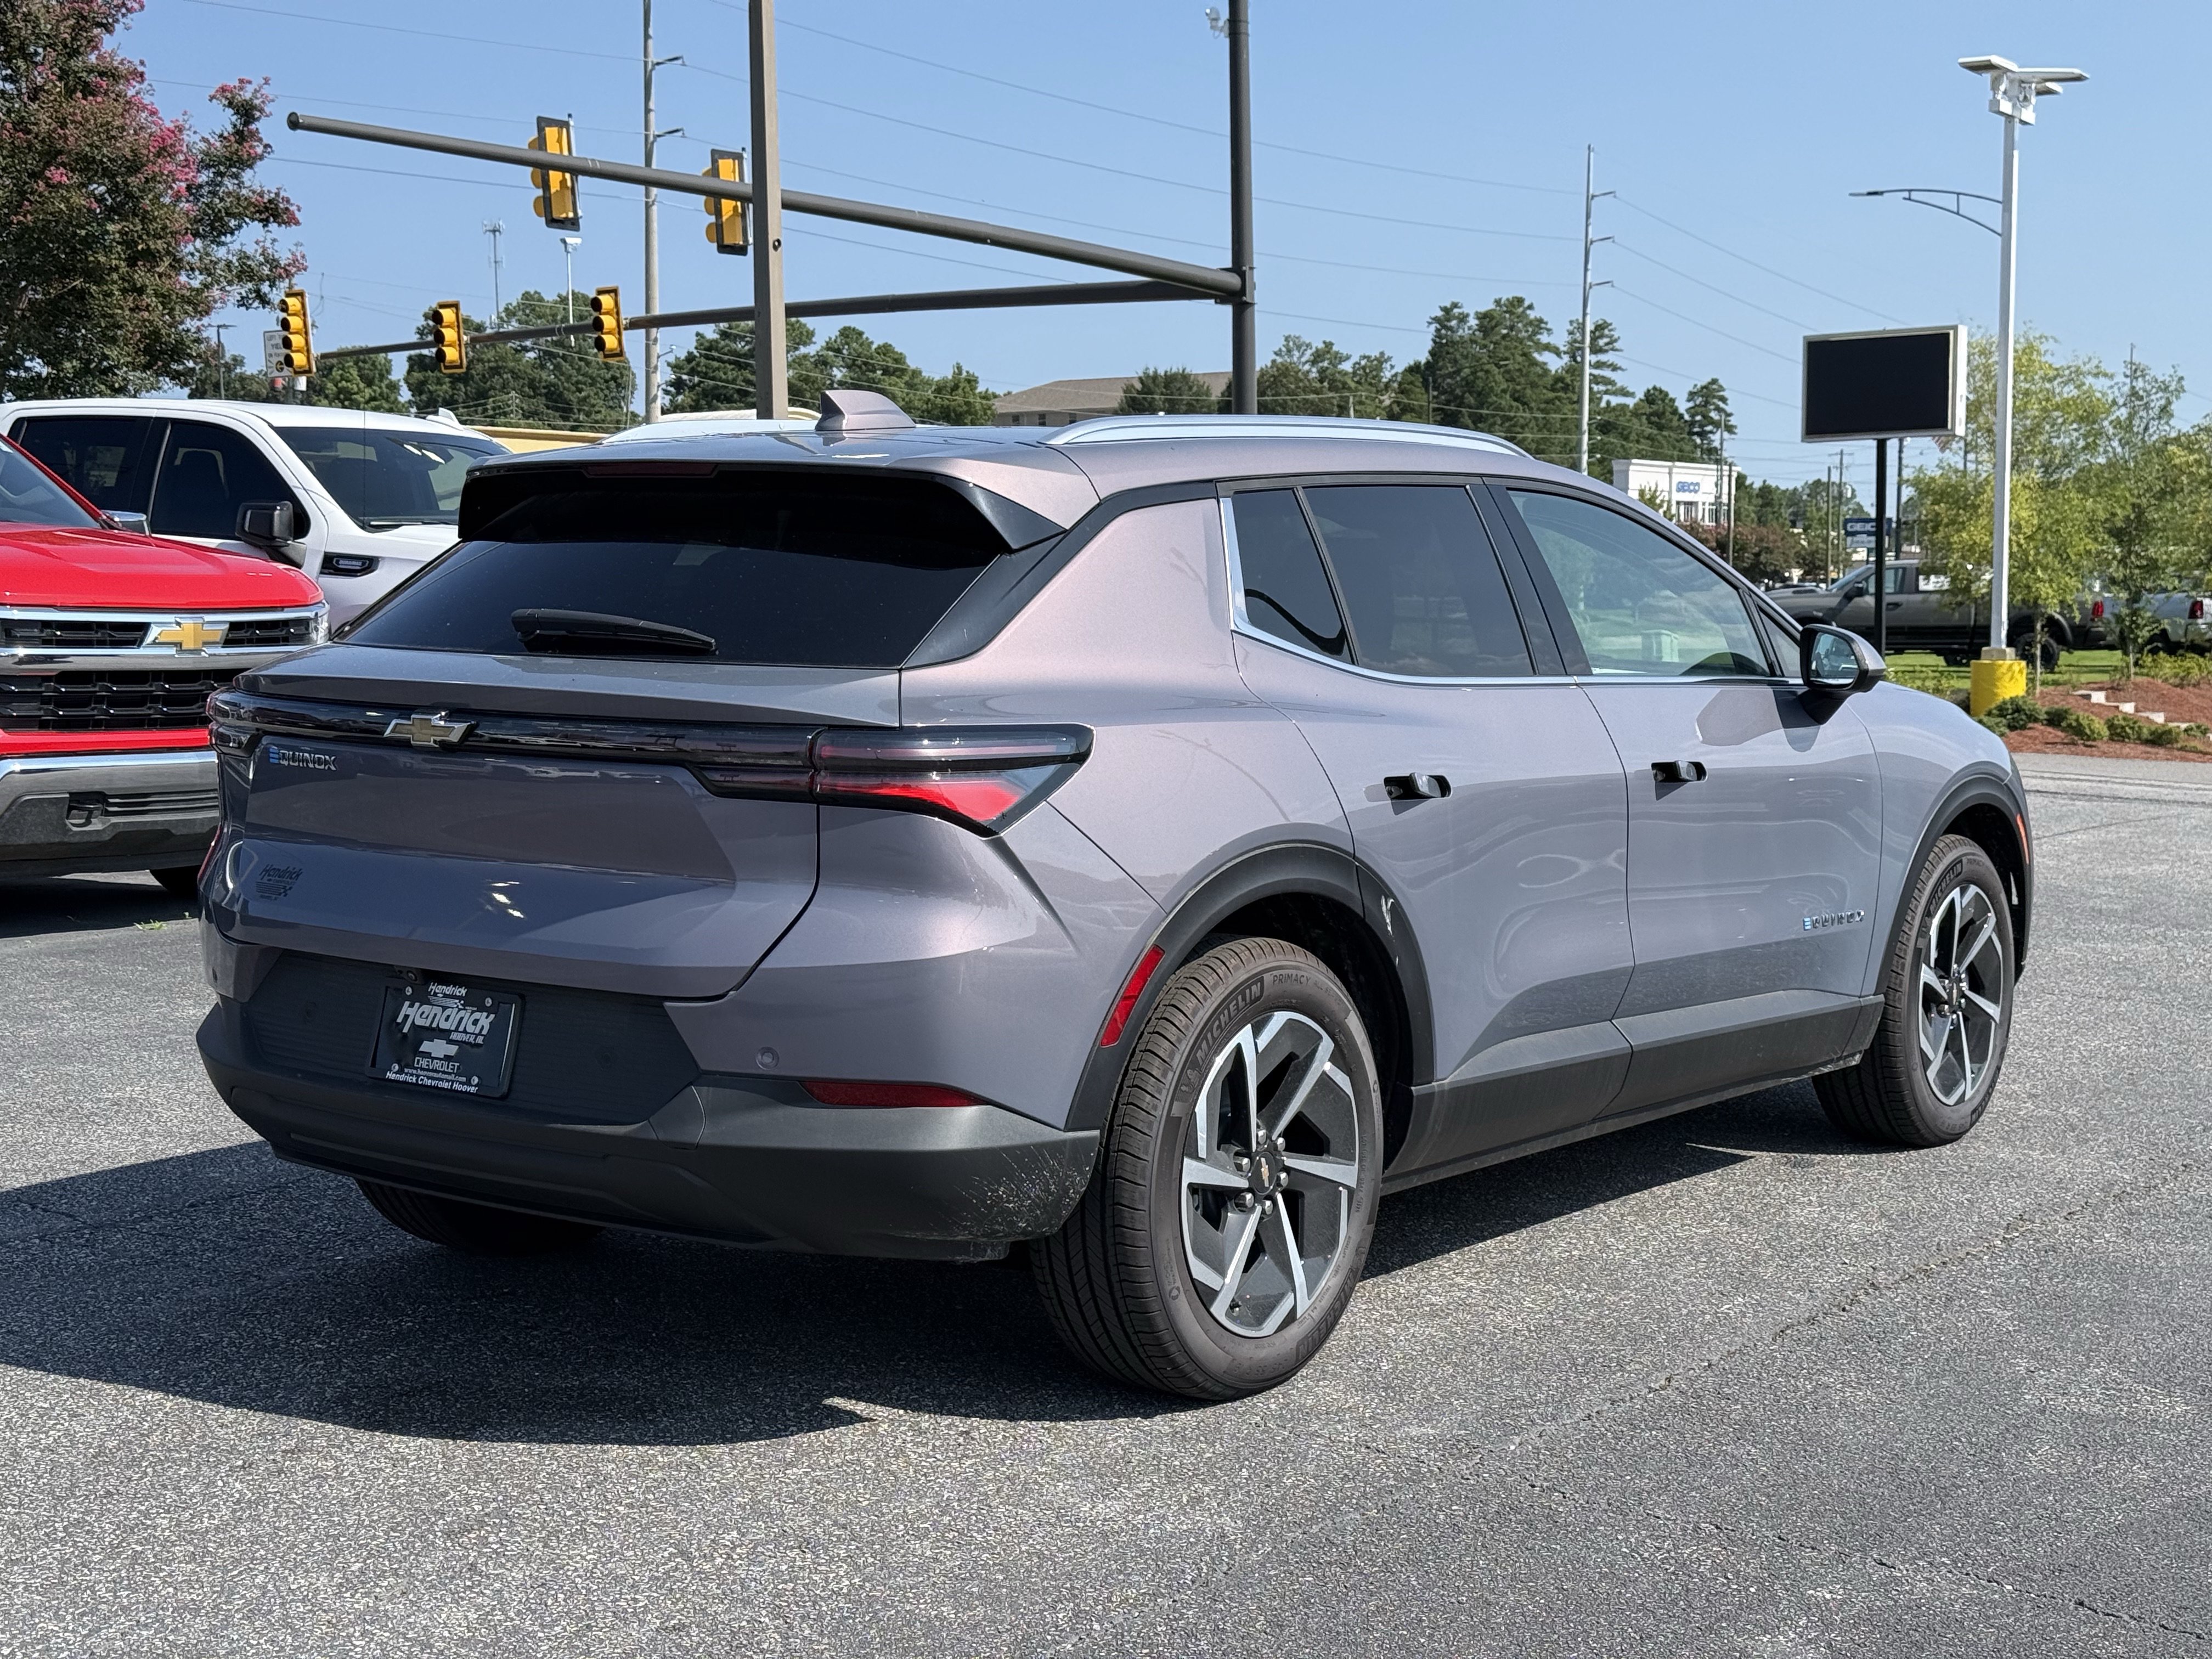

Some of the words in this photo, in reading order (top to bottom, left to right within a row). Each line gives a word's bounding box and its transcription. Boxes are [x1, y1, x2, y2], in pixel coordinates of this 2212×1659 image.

[1676, 481, 1700, 494] GEICO
[1847, 523, 1876, 532] GEIC
[269, 746, 337, 771] EQUINOX
[259, 864, 303, 881] Hendrick
[1803, 909, 1865, 931] EQUINOX
[1273, 973, 1311, 985] PRIMACY
[428, 981, 467, 997] Hendrick
[396, 1001, 495, 1035] Hendrick
[1197, 981, 1261, 1066] MICHELIN
[414, 1057, 460, 1073] CHEVROLET
[386, 1070, 417, 1084] Hendrick
[418, 1076, 452, 1090] Chevrolet
[453, 1082, 478, 1093] Hoover
